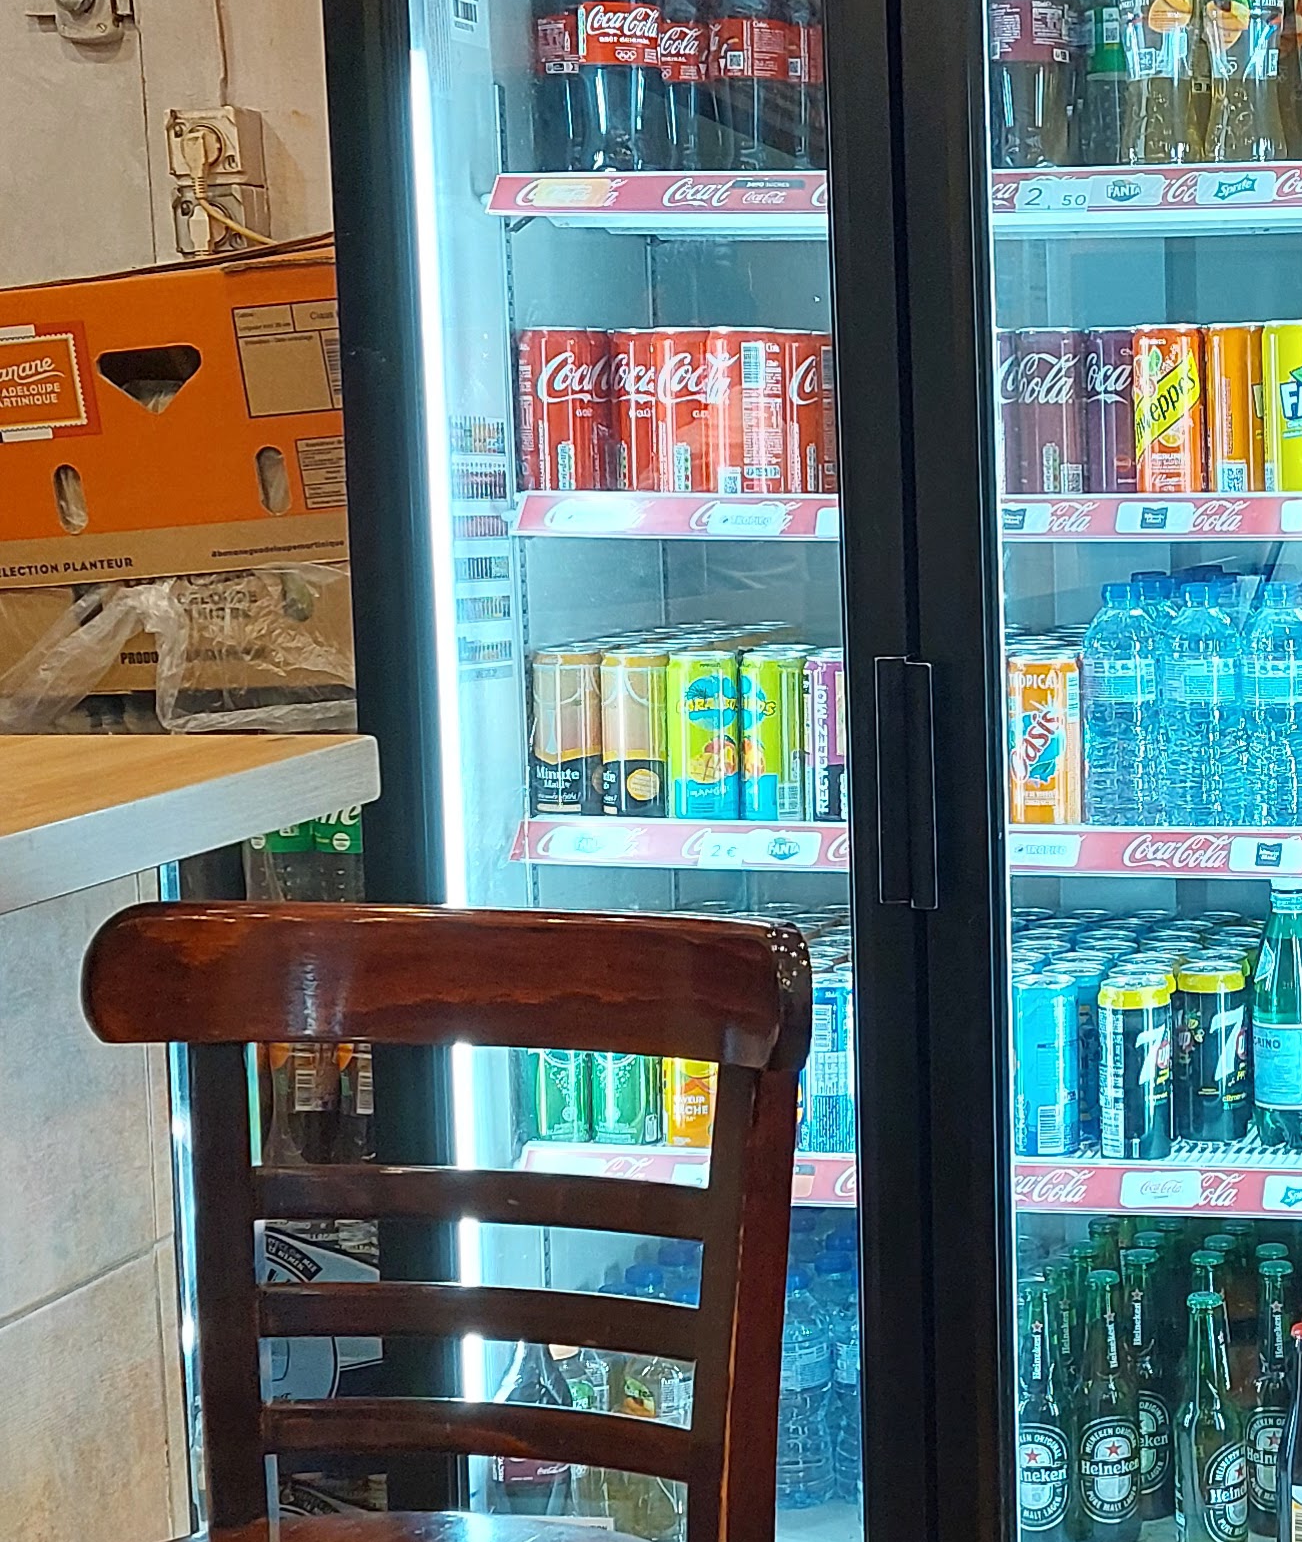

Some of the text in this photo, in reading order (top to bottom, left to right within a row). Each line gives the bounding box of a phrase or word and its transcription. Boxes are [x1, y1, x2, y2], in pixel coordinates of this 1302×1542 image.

[1106, 185, 1143, 200] FANTA
[0, 382, 61, 397] ADELOUPE
[0, 556, 134, 578] LECTION PLANTEUR
[1123, 833, 1237, 870] Coca-Cola
[1080, 1457, 1140, 1477] Heineken
